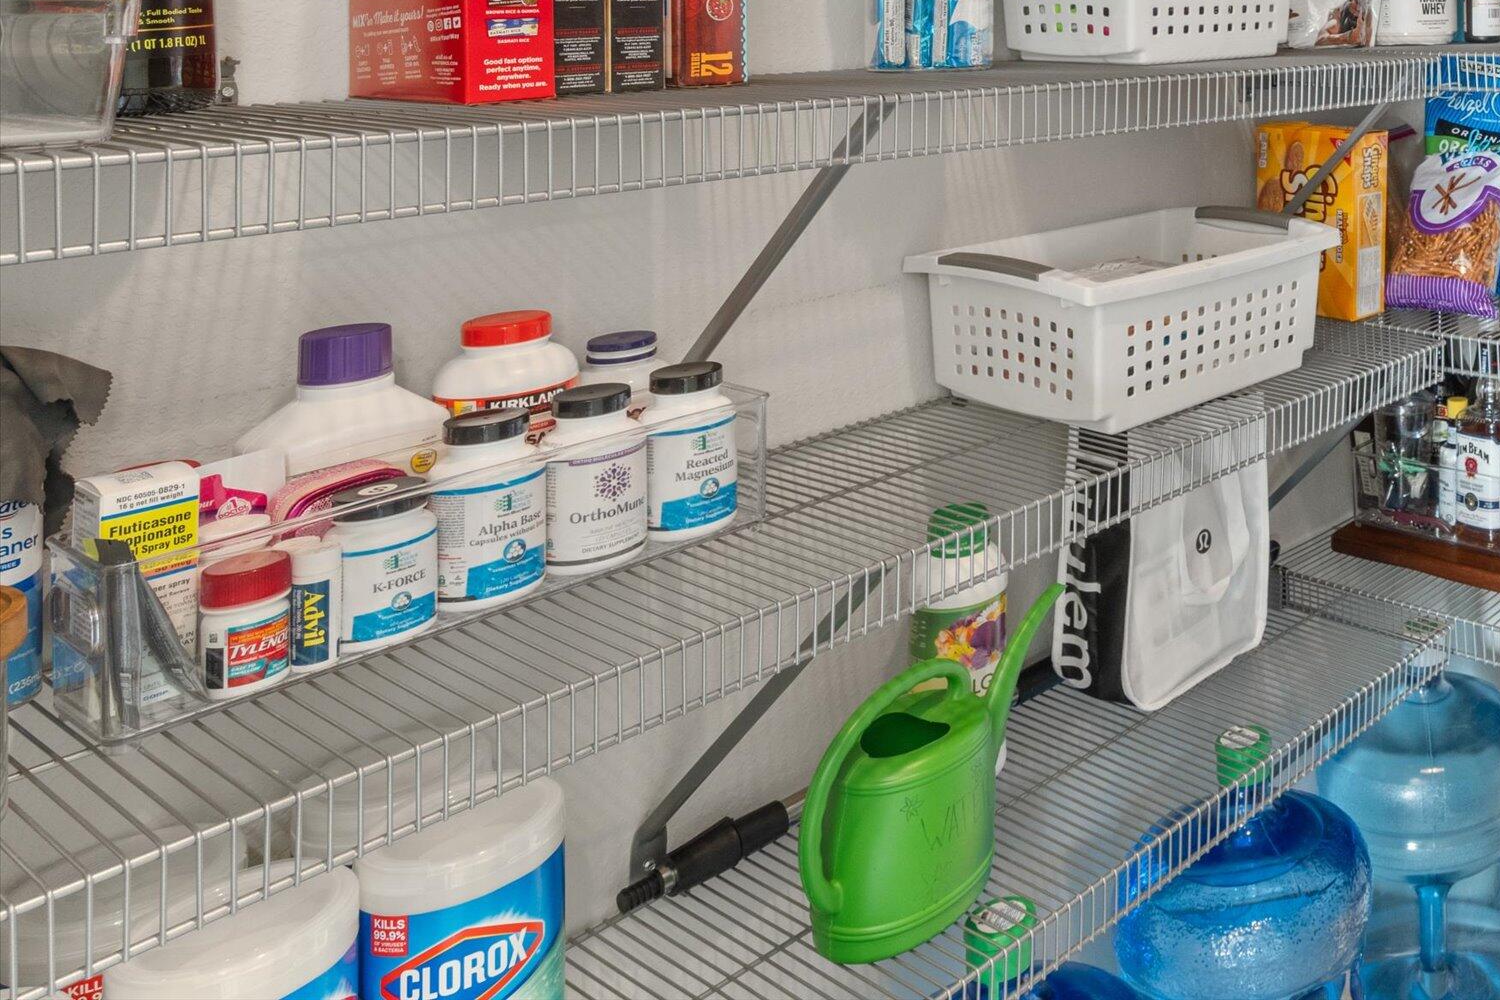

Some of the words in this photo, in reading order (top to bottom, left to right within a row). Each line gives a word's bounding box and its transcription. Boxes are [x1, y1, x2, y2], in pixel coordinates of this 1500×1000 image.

[163, 8, 187, 16] Bodied
[1421, 3, 1446, 15] WHEY
[146, 17, 175, 25] Smooth
[144, 38, 156, 50] QT
[159, 37, 173, 48] 1.8
[175, 36, 184, 47] FL
[185, 35, 198, 47] OZ)
[700, 50, 734, 77] 12
[685, 449, 729, 470] Reacted
[1468, 442, 1490, 465] BEAM
[674, 458, 735, 483] Magnesium
[116, 495, 133, 504] NDC
[136, 499, 148, 507] net
[160, 490, 184, 503] weight
[109, 510, 192, 538] Fluticasone
[478, 520, 518, 543] Alpha
[521, 510, 543, 526] Base
[141, 541, 171, 557] Spray
[173, 533, 194, 546] USP
[469, 534, 508, 549] Capsules
[372, 568, 427, 594] K-FORCE
[303, 590, 326, 648] Advil
[373, 918, 406, 930] KILLS
[373, 930, 406, 941] 99.9%
[400, 926, 528, 1000] CLOROX
